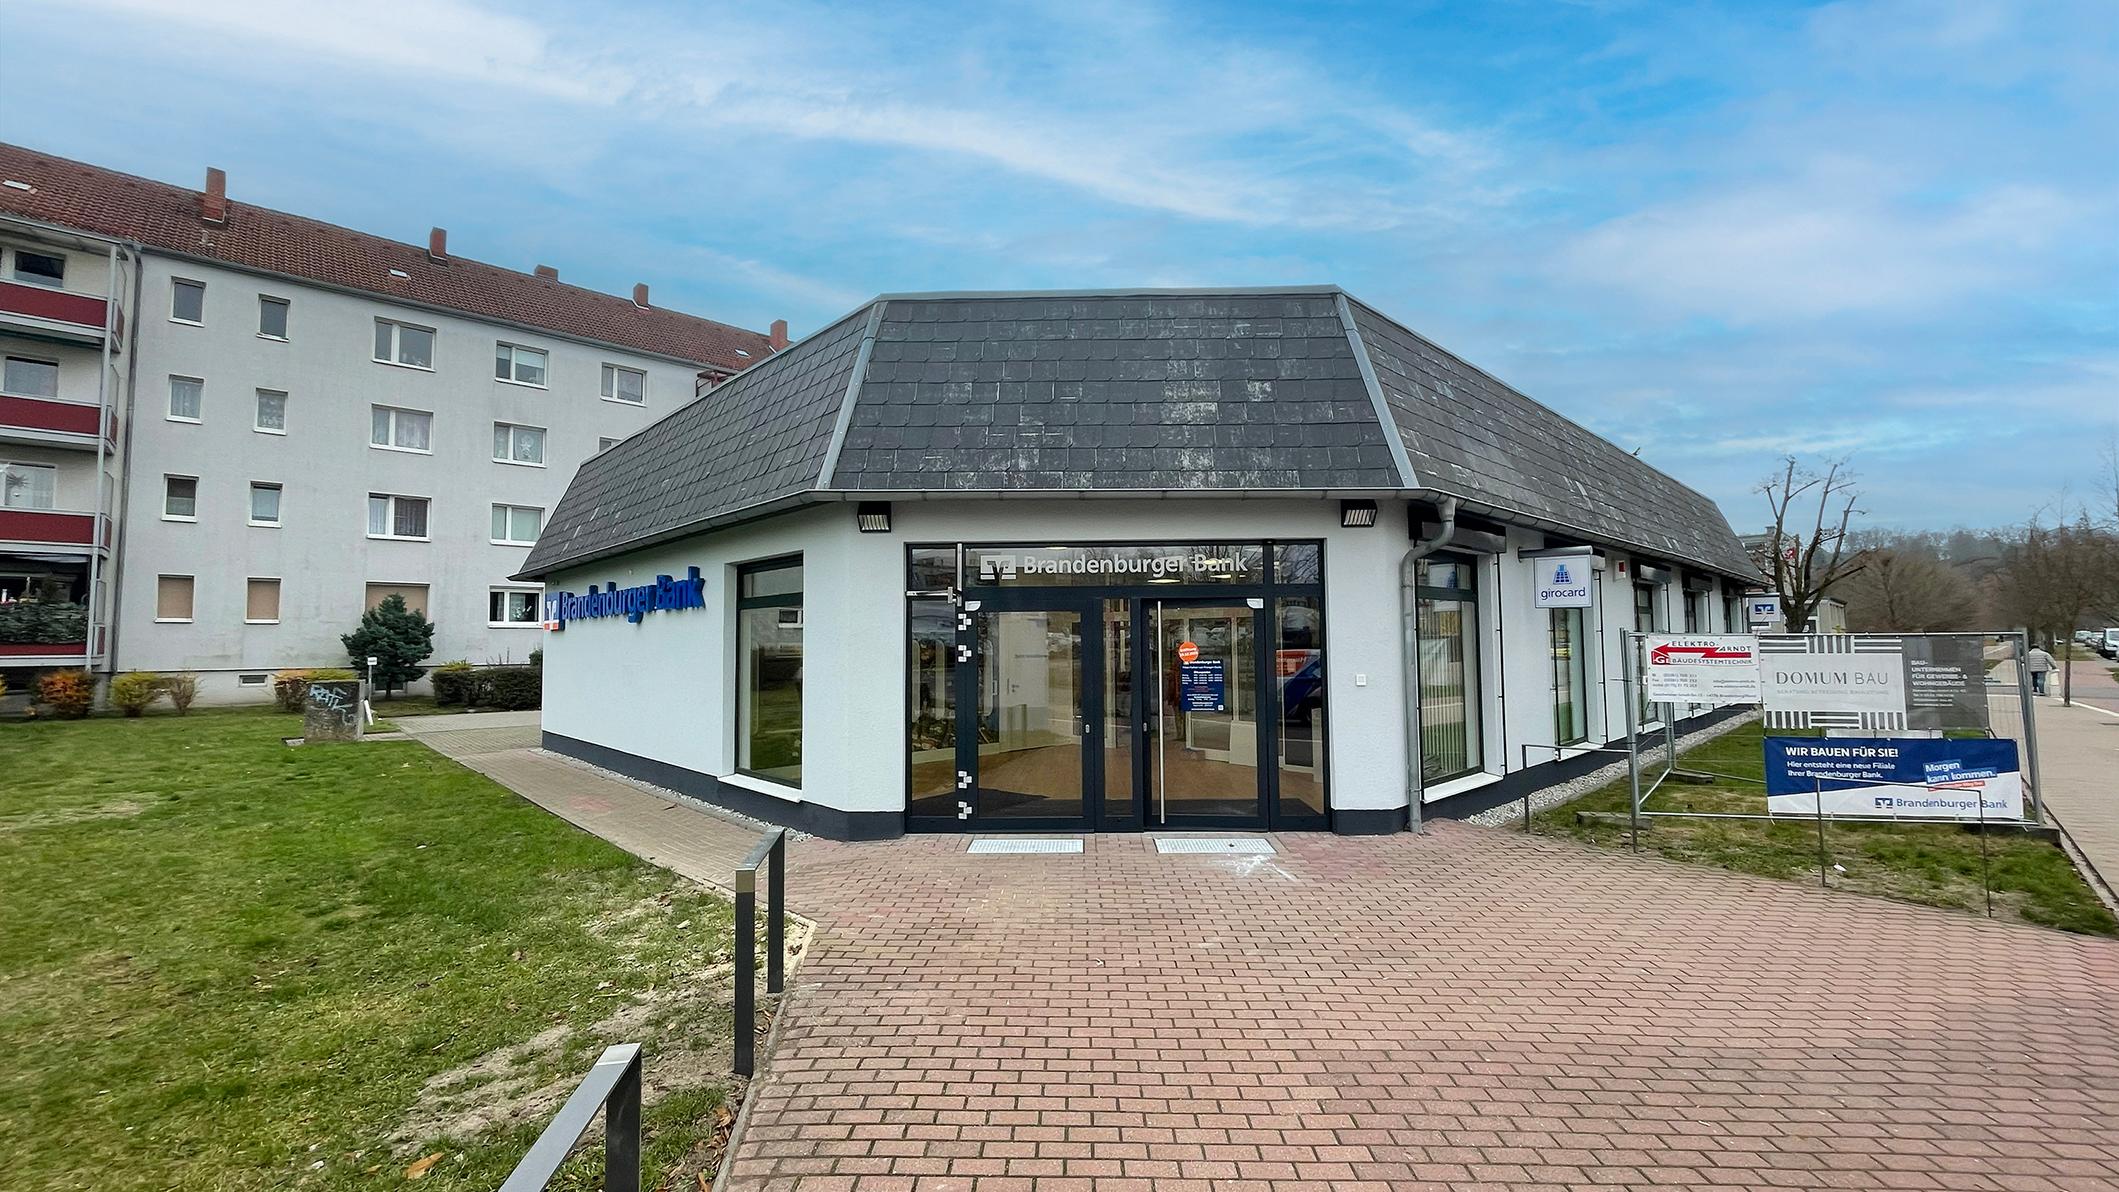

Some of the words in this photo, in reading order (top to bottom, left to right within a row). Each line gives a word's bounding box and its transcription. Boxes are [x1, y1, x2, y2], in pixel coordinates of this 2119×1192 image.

[1024, 554, 1186, 578] Brandenburger
[1194, 553, 1249, 572] Bank
[561, 582, 657, 624] Brandenburger
[656, 566, 707, 610] Bank
[1540, 587, 1586, 600] girocard
[1776, 671, 1847, 685] DOMUM
[1854, 672, 1889, 685] BAU
[1785, 746, 1809, 756] WIR
[1810, 747, 1850, 757] BAUEN
[1852, 745, 1877, 757] FÜR
[1877, 748, 1899, 758] SIE!
[1803, 761, 1835, 769] entsteht
[1872, 762, 1896, 770] Filiale
[1925, 761, 1960, 773] Morgen
[1787, 769, 1806, 777] Ihrer
[1806, 770, 1862, 779] Brandenburger
[1927, 773, 1949, 783] kann
[1951, 769, 1996, 781] kommen.
[1896, 798, 1977, 810] Brandenburger
[1981, 798, 2008, 809] Bank
